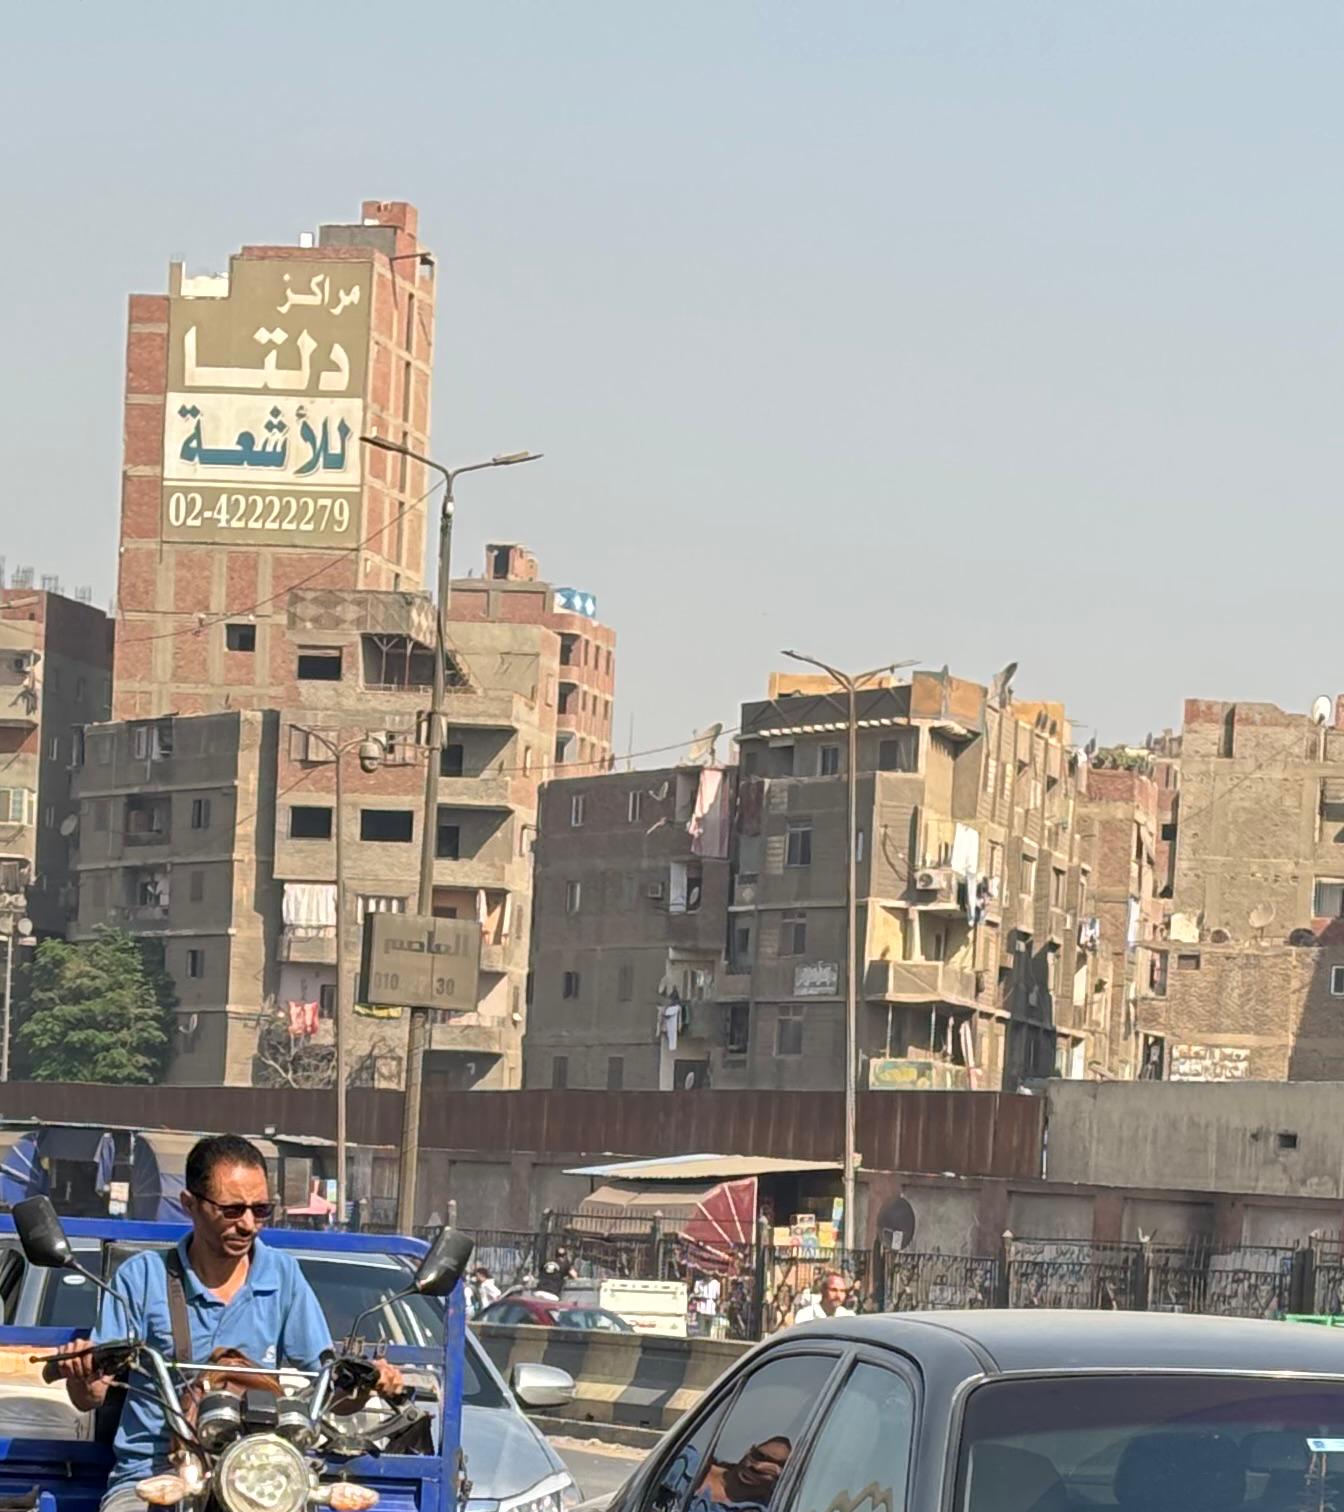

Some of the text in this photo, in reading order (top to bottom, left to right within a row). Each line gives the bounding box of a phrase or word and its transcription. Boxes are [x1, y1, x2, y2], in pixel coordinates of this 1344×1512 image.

[277, 273, 360, 315] مراكز
[183, 326, 351, 391] دلتا
[177, 404, 353, 476] للأشعة
[169, 491, 350, 533] 02-42222279
[435, 978, 455, 996] 30
